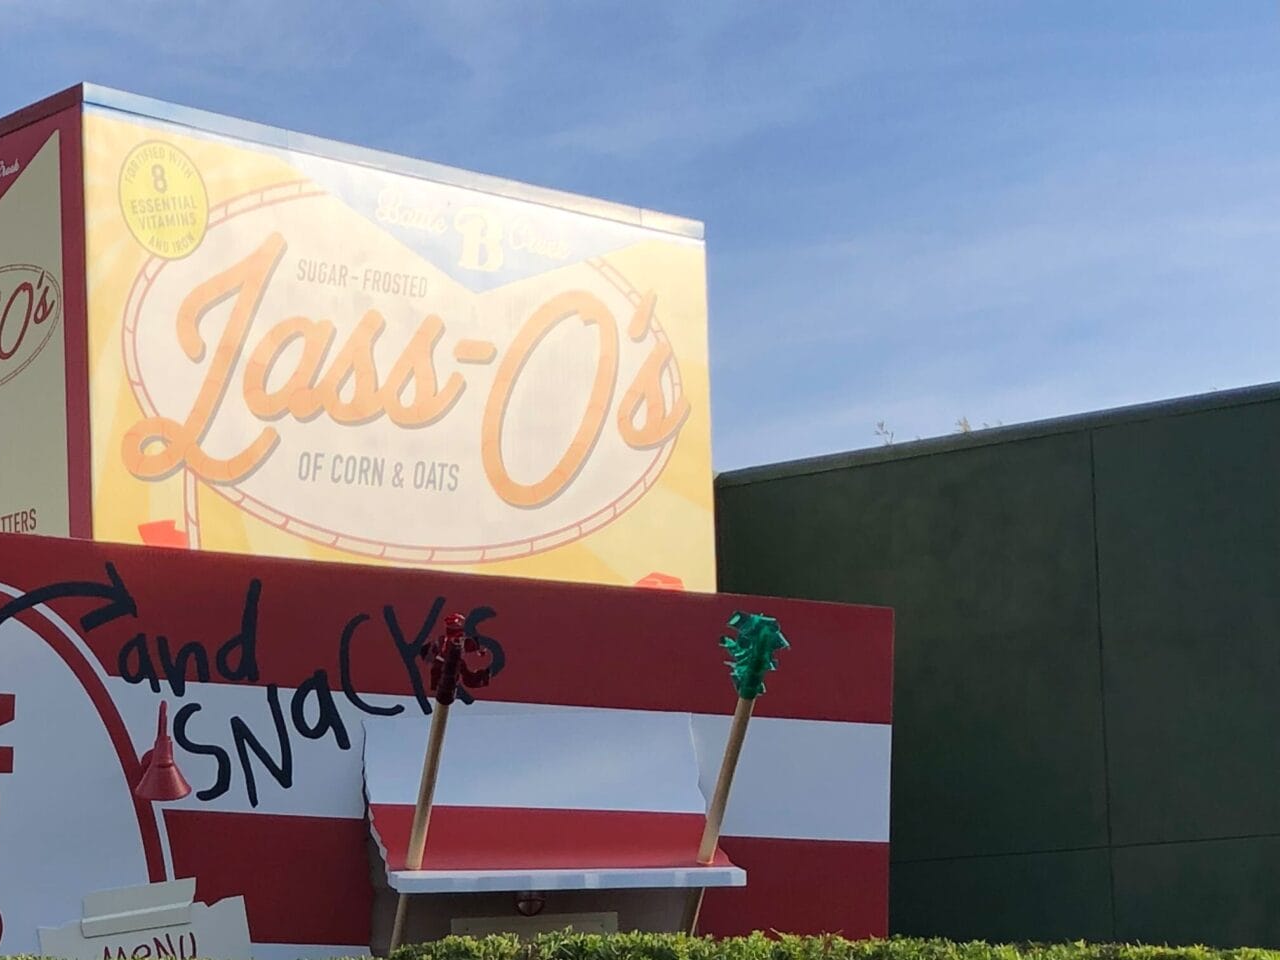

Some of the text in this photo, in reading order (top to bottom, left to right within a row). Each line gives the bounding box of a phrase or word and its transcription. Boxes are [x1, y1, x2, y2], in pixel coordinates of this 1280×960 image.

[124, 146, 195, 184] FORTIFIED WITH
[151, 164, 168, 194] 8
[130, 195, 198, 214] ESSENTIAL
[138, 212, 198, 230] VITAMINS
[148, 231, 195, 253] AND IRON
[298, 451, 460, 492] OF CORN & OATS
[118, 579, 261, 697] and
